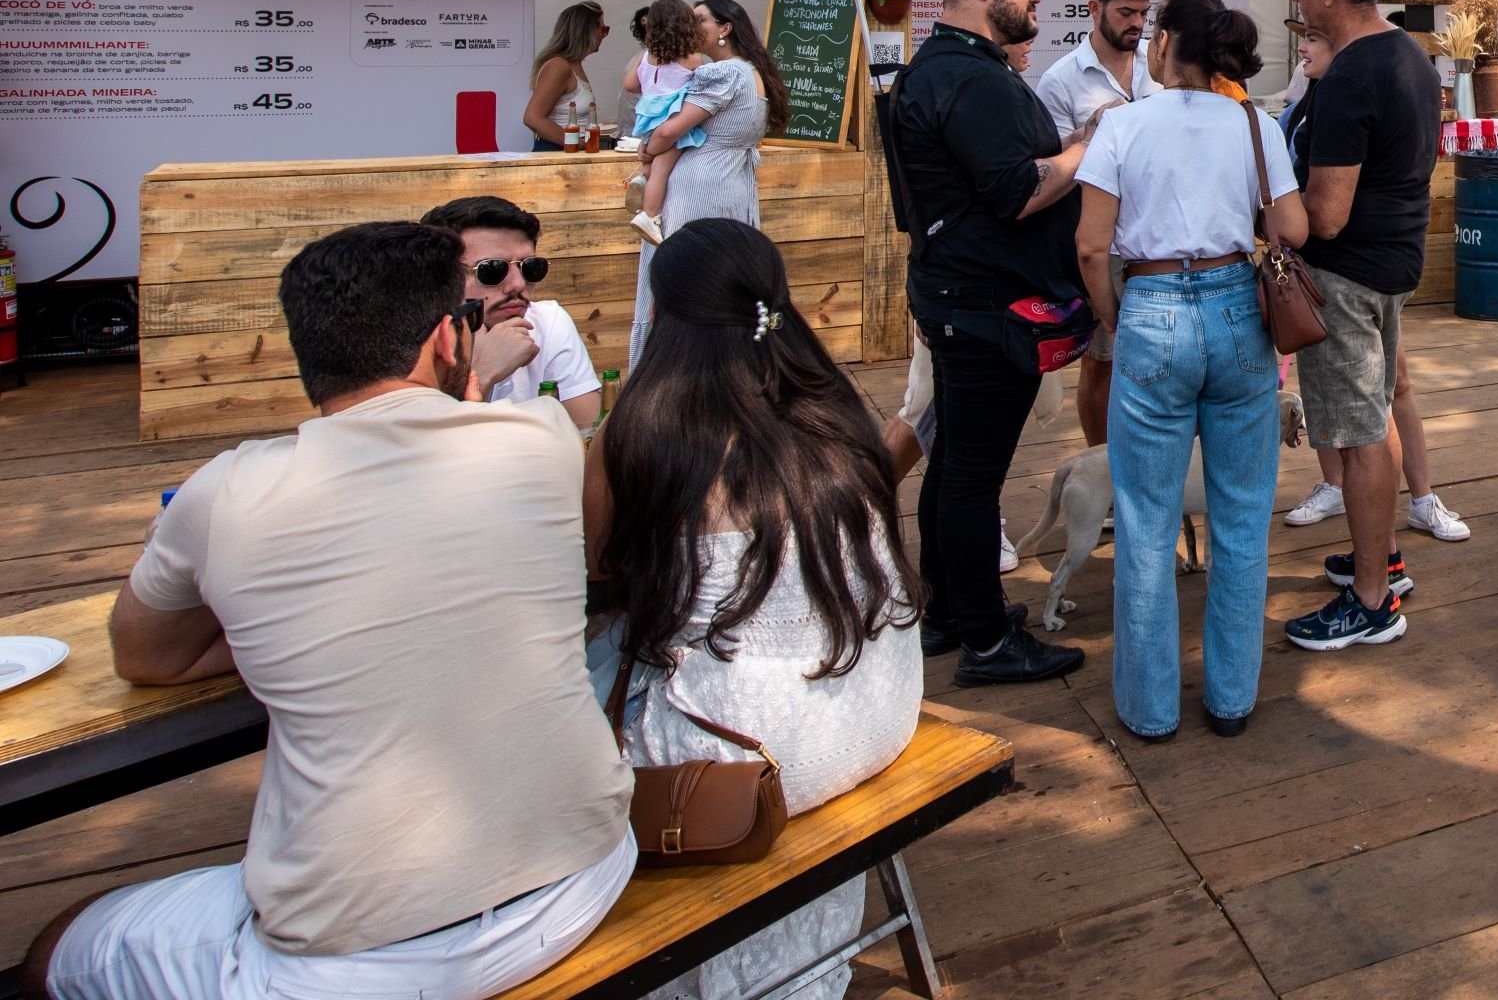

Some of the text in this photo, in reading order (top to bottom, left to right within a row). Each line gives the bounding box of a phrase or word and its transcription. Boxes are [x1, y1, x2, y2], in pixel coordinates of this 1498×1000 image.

[46, 1, 67, 9] DE
[71, 0, 96, 9] VÓ:
[381, 17, 427, 25] bradesco
[439, 13, 488, 21] FARTURA
[235, 19, 250, 28] R$
[1051, 38, 1061, 46] R$
[157, 51, 191, 59] barriga
[92, 88, 157, 97] MINEIRA:
[161, 105, 187, 113] pequi
[233, 103, 249, 111] R$
[1328, 612, 1368, 636] FILA
